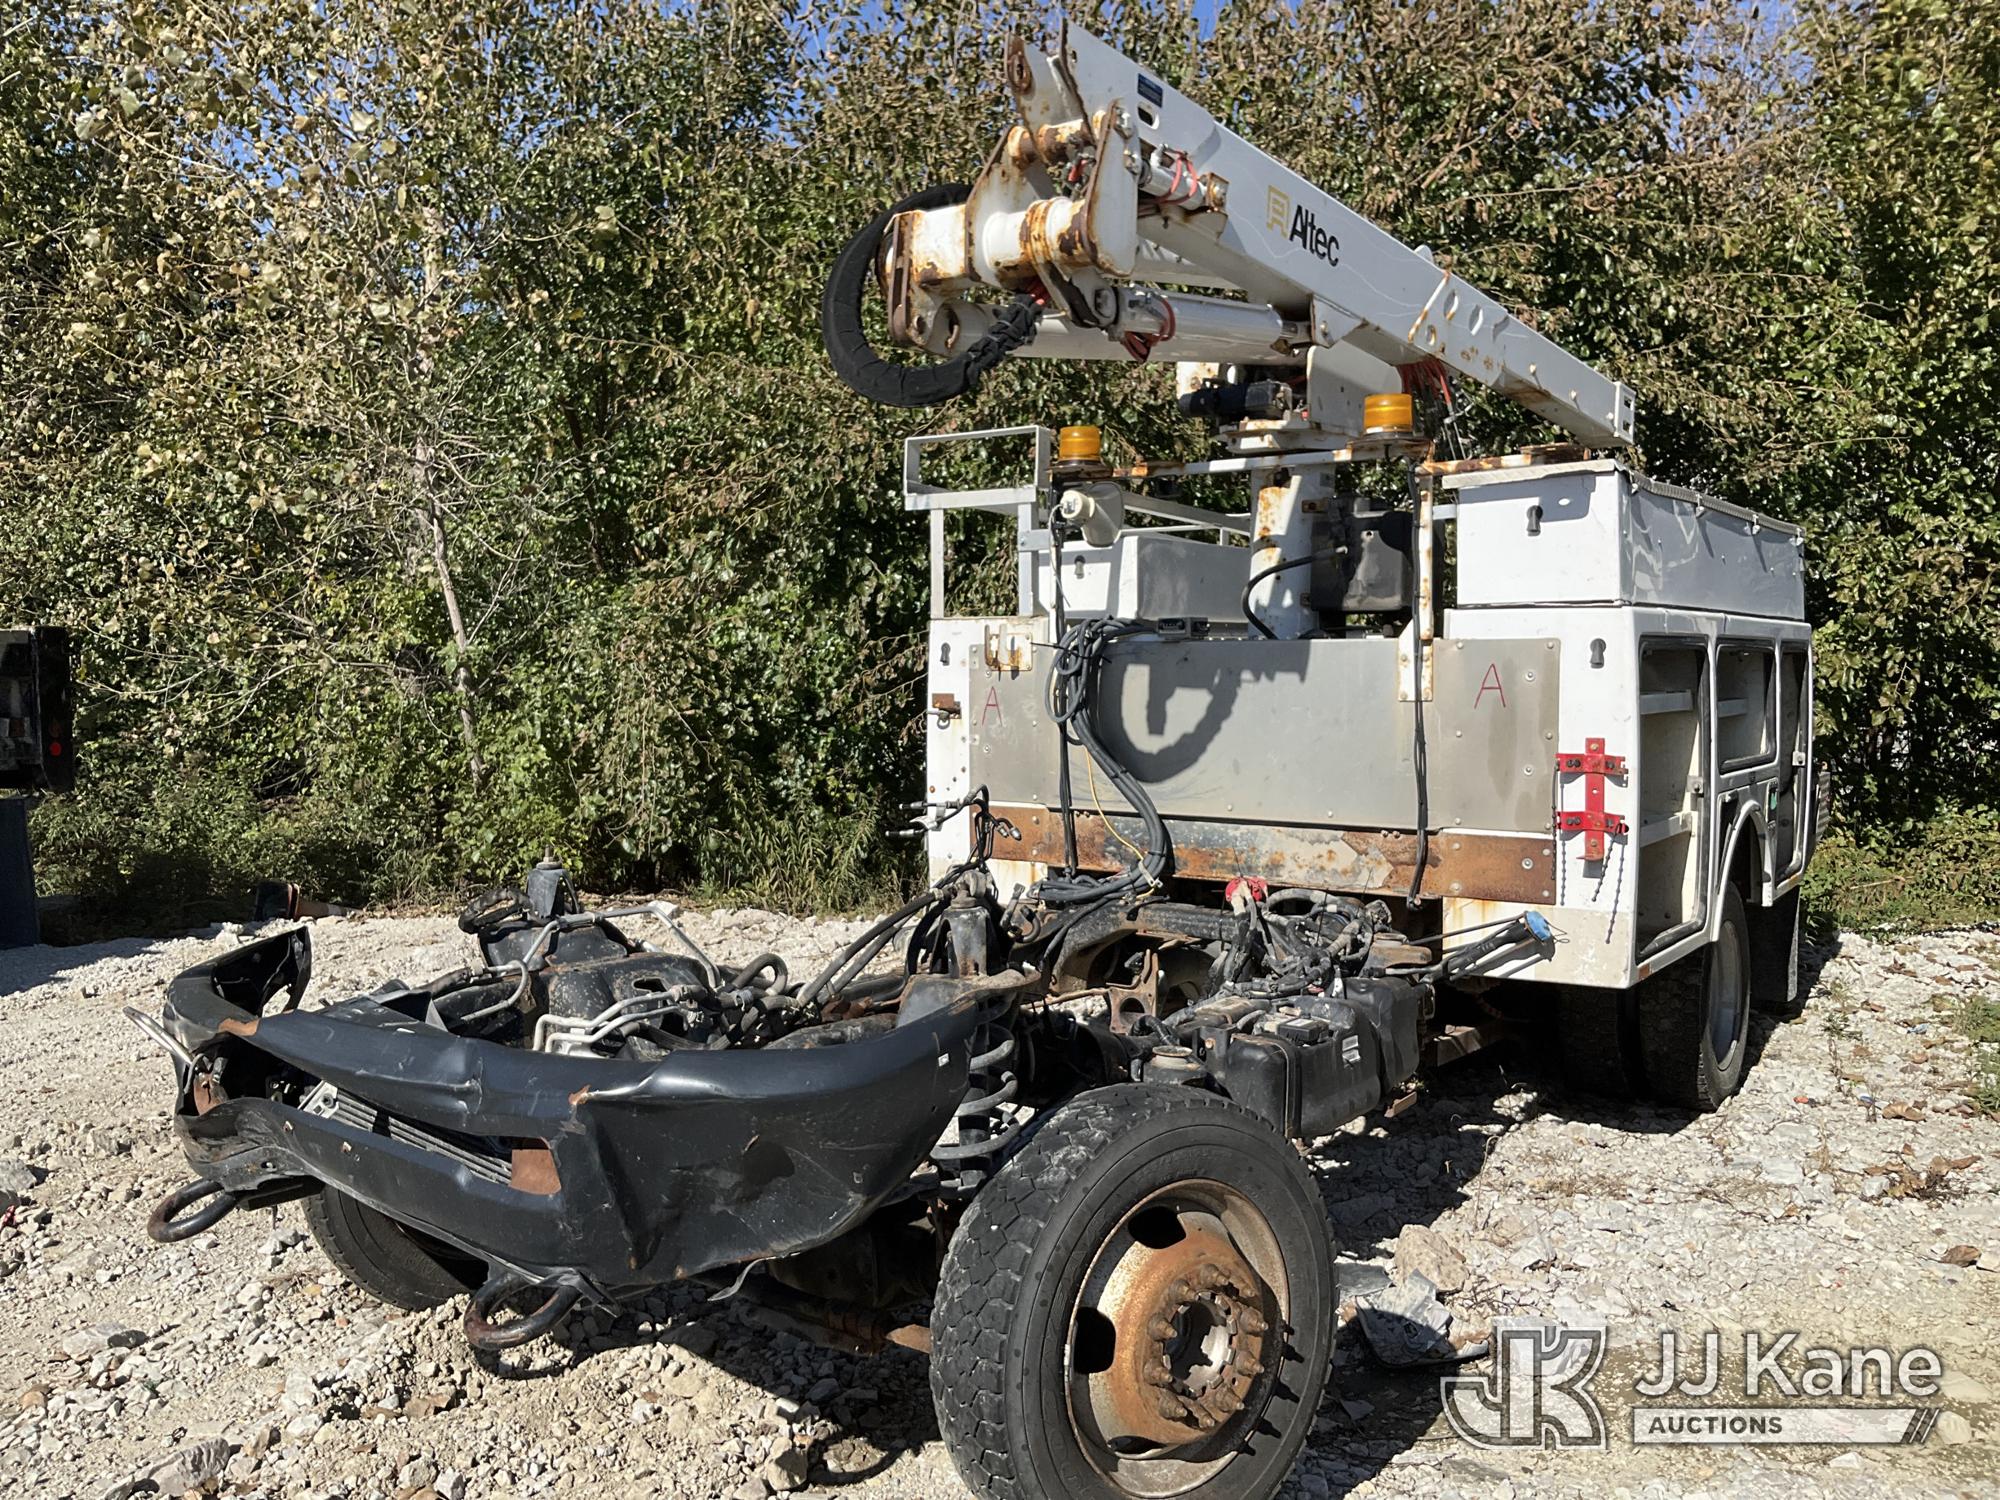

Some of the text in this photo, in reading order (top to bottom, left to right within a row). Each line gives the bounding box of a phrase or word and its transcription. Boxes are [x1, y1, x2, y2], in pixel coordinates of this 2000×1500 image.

[1289, 204, 1339, 267] Altec
[982, 686, 1003, 728] A
[1474, 663, 1506, 709] A
